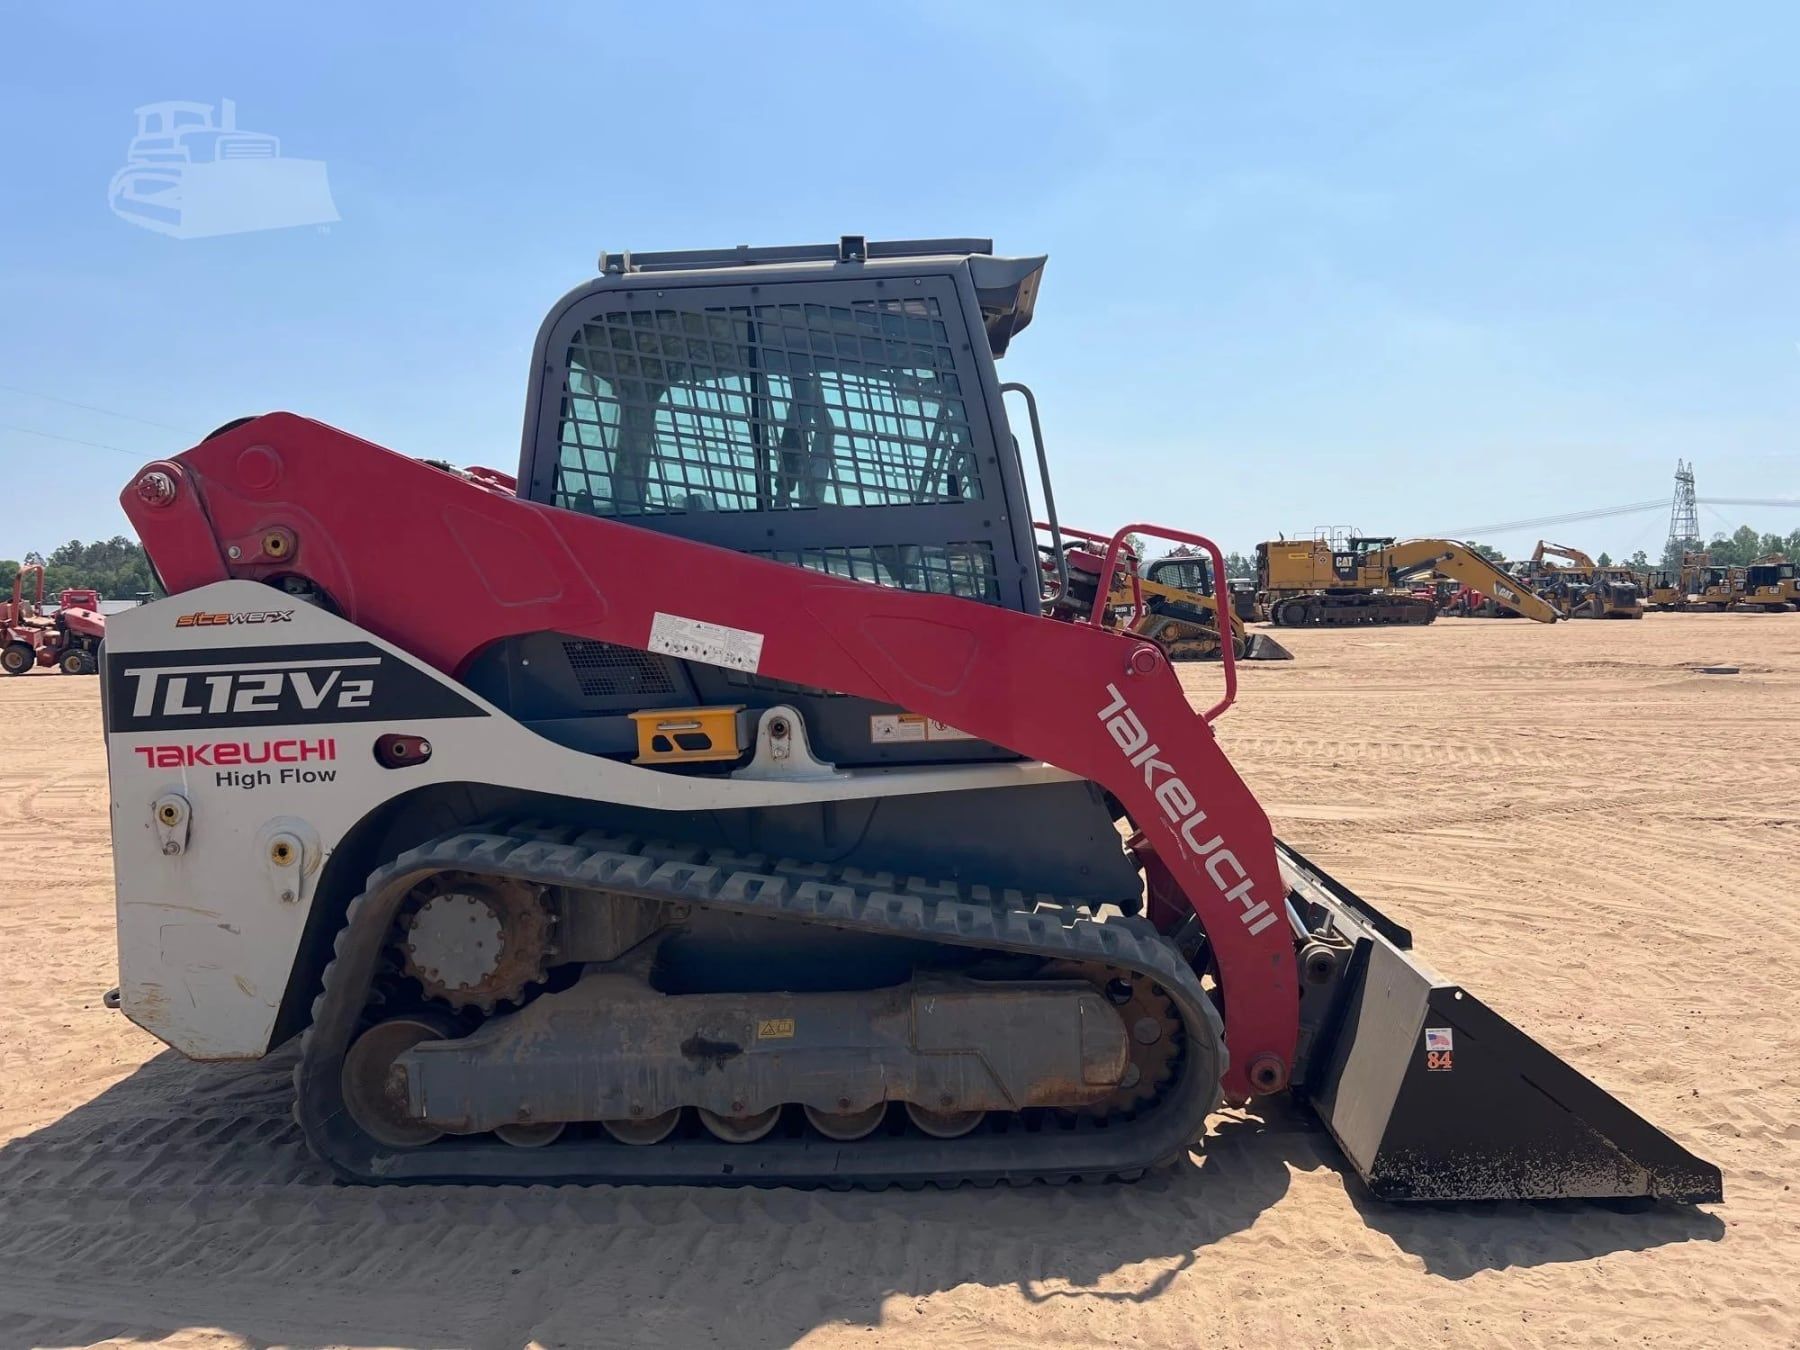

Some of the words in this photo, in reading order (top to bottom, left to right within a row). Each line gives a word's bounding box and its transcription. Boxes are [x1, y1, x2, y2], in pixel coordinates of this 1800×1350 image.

[1336, 556, 1353, 567] CAT
[1499, 587, 1514, 600] CAT
[176, 610, 295, 627] sitewerx
[135, 738, 337, 768] TAKEUCHI
[215, 769, 271, 790] High
[280, 768, 337, 784] Flow
[1097, 683, 1279, 936] TAKEUCHI
[1427, 1051, 1452, 1069] 84
